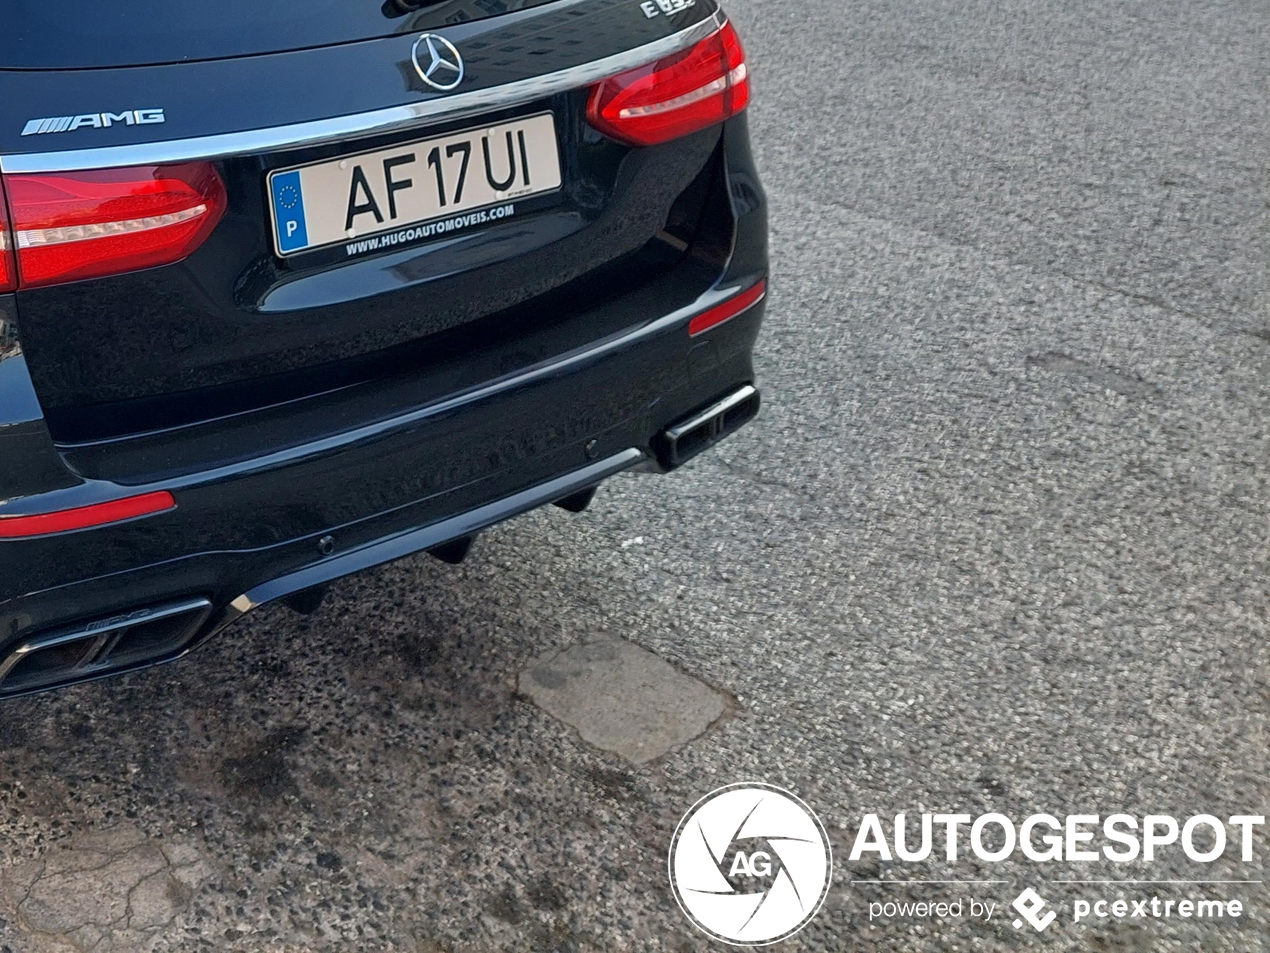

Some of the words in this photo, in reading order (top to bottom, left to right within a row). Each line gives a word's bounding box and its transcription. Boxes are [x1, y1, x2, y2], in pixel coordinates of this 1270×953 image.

[68, 108, 165, 132] AMG
[345, 153, 416, 232] AF
[427, 140, 472, 207] 17
[482, 129, 531, 191] UI
[286, 219, 298, 238] P
[345, 204, 515, 256] WWW.HUGOAUTOMOVEIS.COM
